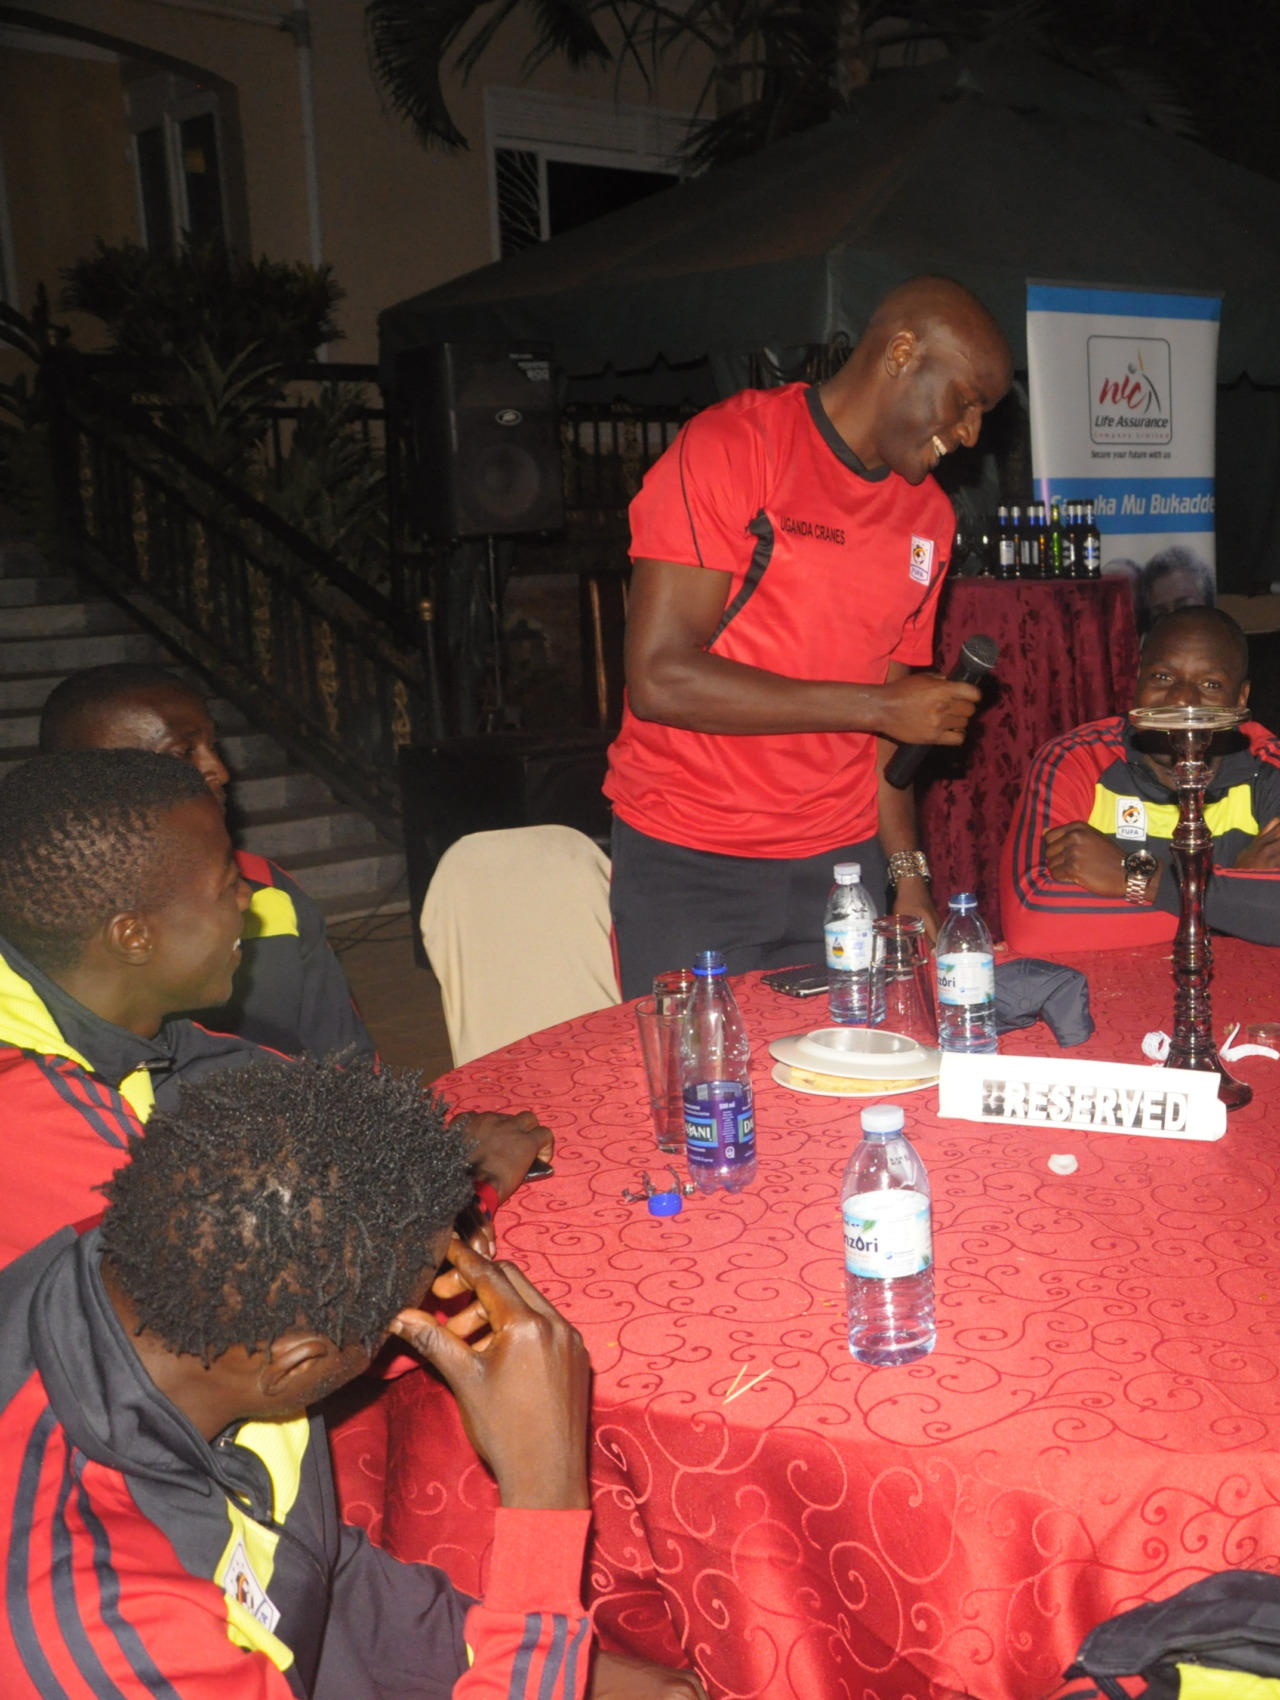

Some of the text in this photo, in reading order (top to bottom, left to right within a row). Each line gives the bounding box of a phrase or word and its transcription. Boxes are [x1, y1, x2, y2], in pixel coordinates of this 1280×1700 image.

[1095, 414, 1168, 428] Life Assurance
[1121, 494, 1146, 515] Mu
[781, 515, 845, 546] UGANDA CRANES
[1003, 1080, 1189, 1132] RESERVED
